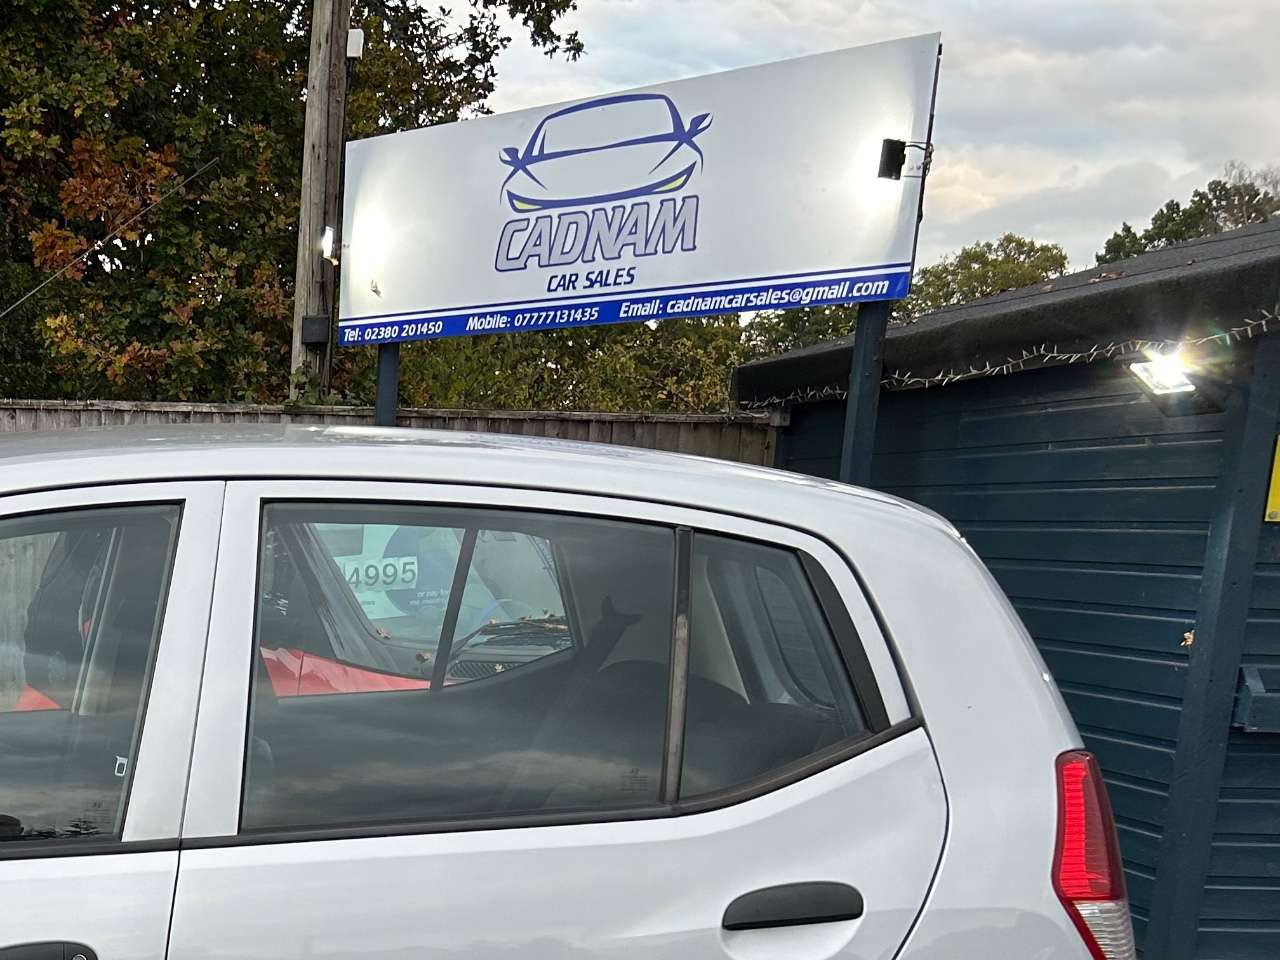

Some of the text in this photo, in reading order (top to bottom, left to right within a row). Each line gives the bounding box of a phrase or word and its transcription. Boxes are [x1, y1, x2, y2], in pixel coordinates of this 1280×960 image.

[495, 195, 700, 272] CADNAM
[547, 267, 636, 292] CAR SALES
[619, 279, 890, 317] Email: cadnamcarsales@gmail.com
[343, 321, 443, 342] Tel: 02380 201450
[466, 307, 599, 331] Mobile: 07777131435
[348, 561, 417, 588] 4995
